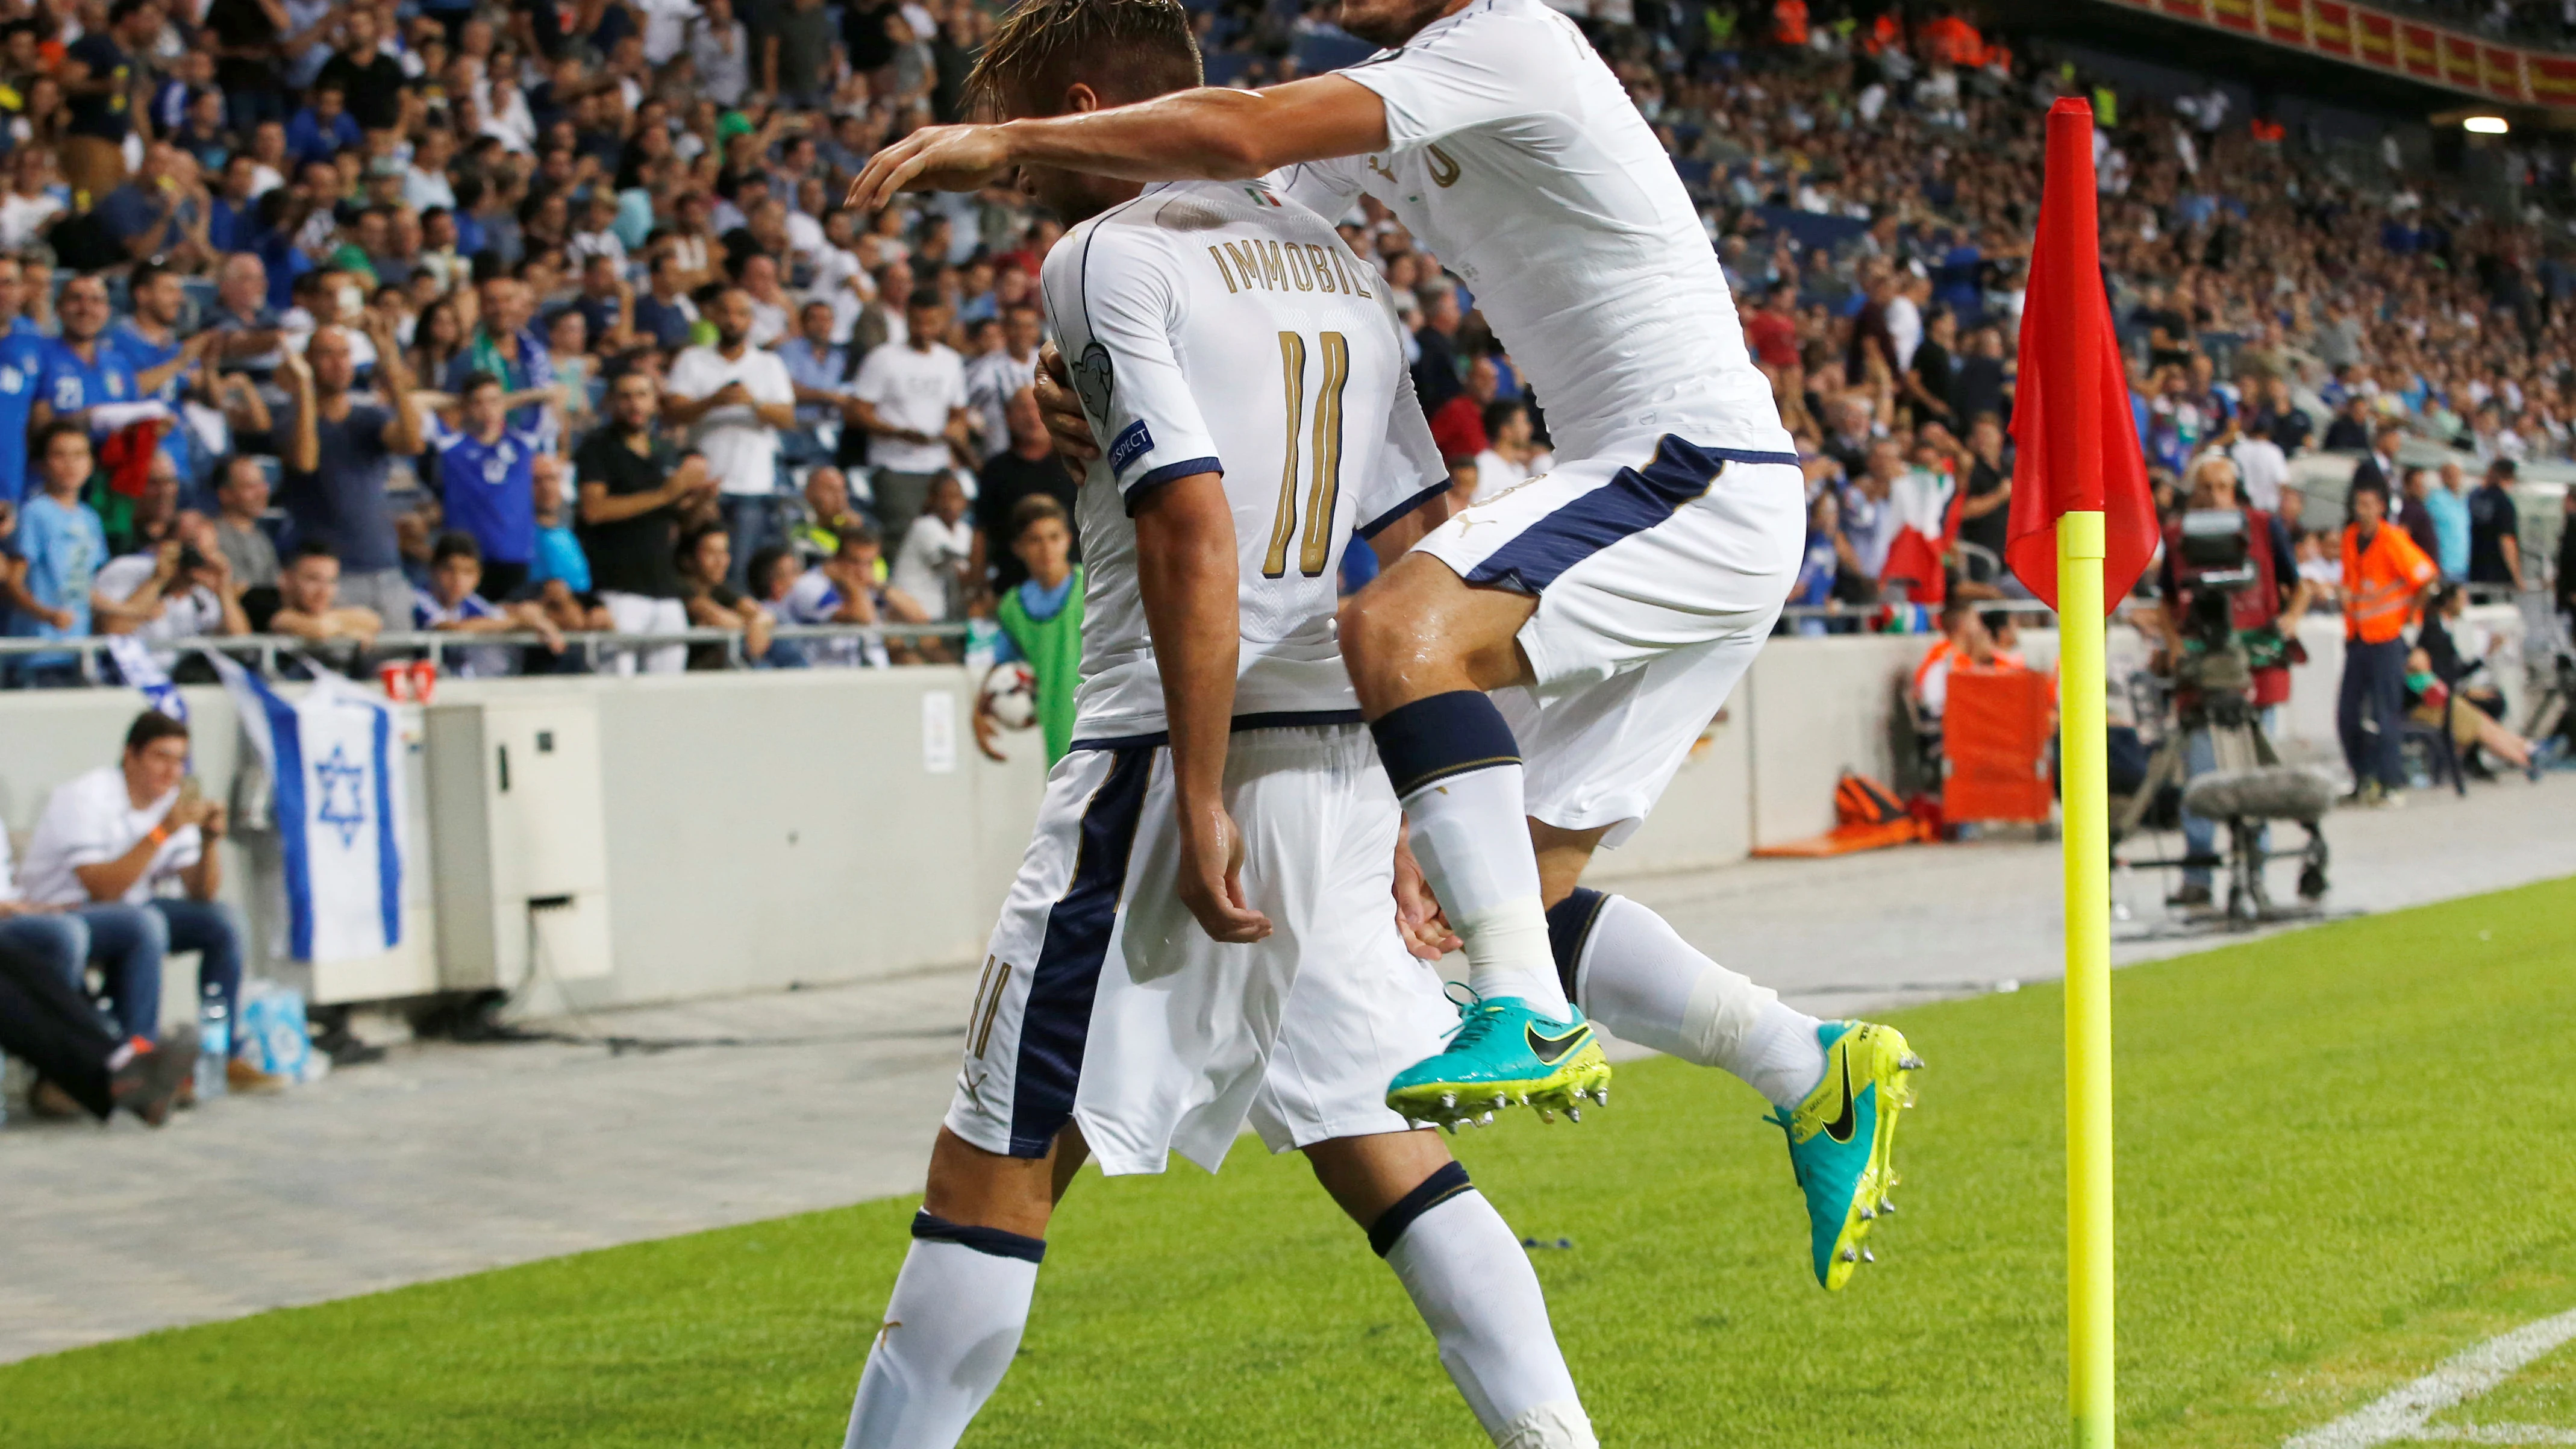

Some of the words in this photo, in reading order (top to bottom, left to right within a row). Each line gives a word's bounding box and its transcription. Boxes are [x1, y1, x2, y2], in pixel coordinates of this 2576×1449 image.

[1110, 428, 1147, 466] ESPECT
[1261, 331, 1349, 579] 11
[966, 954, 1012, 1061] 11
